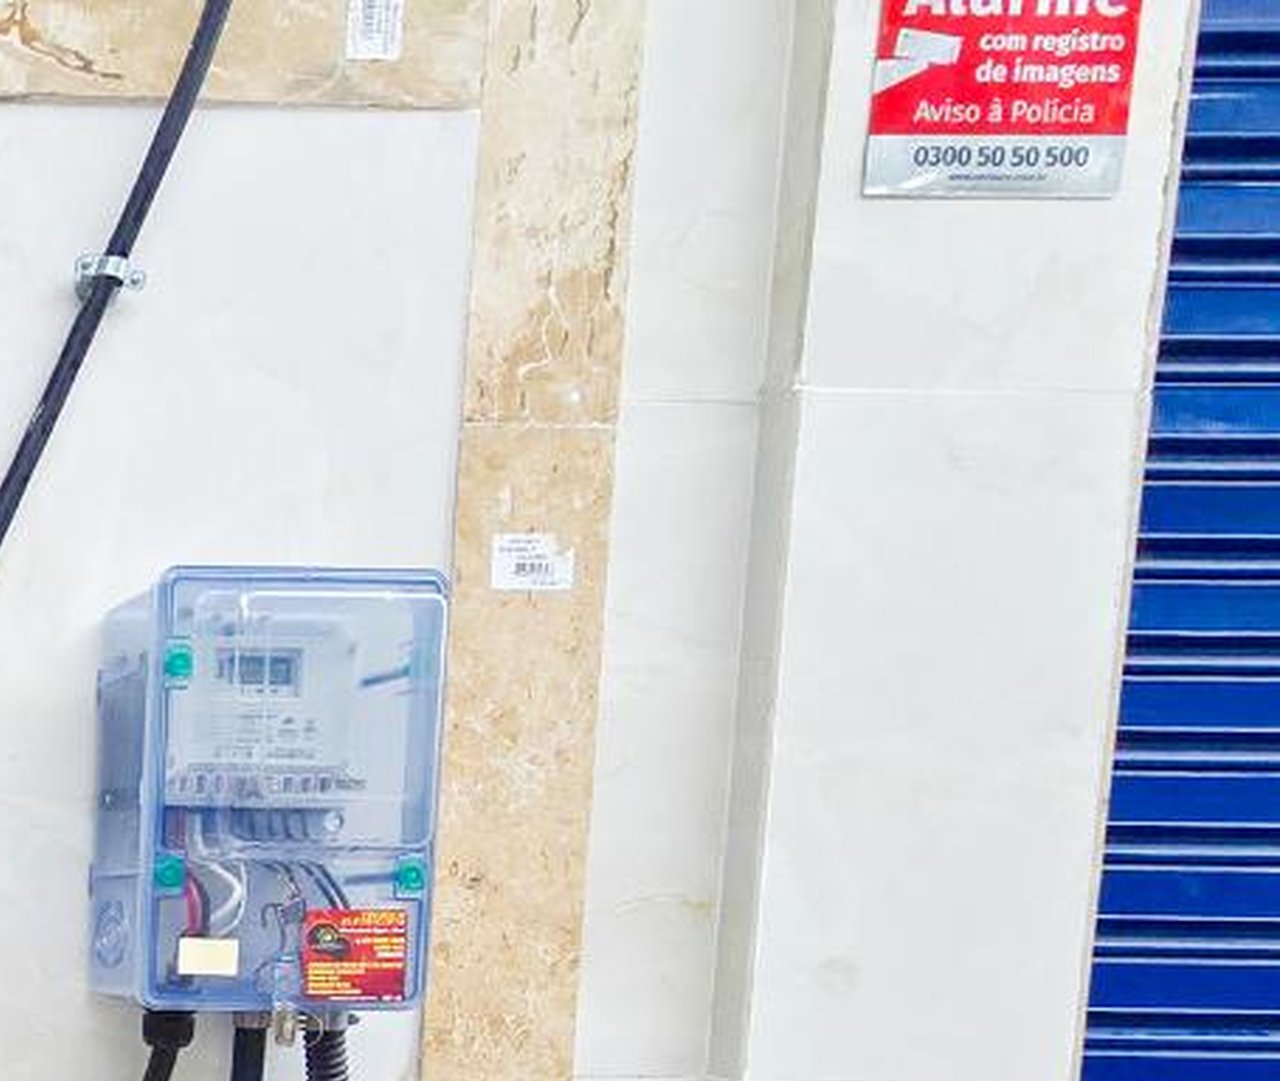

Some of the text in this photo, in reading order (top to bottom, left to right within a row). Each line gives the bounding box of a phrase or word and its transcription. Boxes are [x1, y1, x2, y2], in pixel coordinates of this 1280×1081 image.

[980, 28, 1126, 57] com registro
[975, 57, 1121, 88] de imagens
[913, 97, 1096, 123] Aviso à Polícia
[913, 145, 1090, 167] 0300 50 50 500
